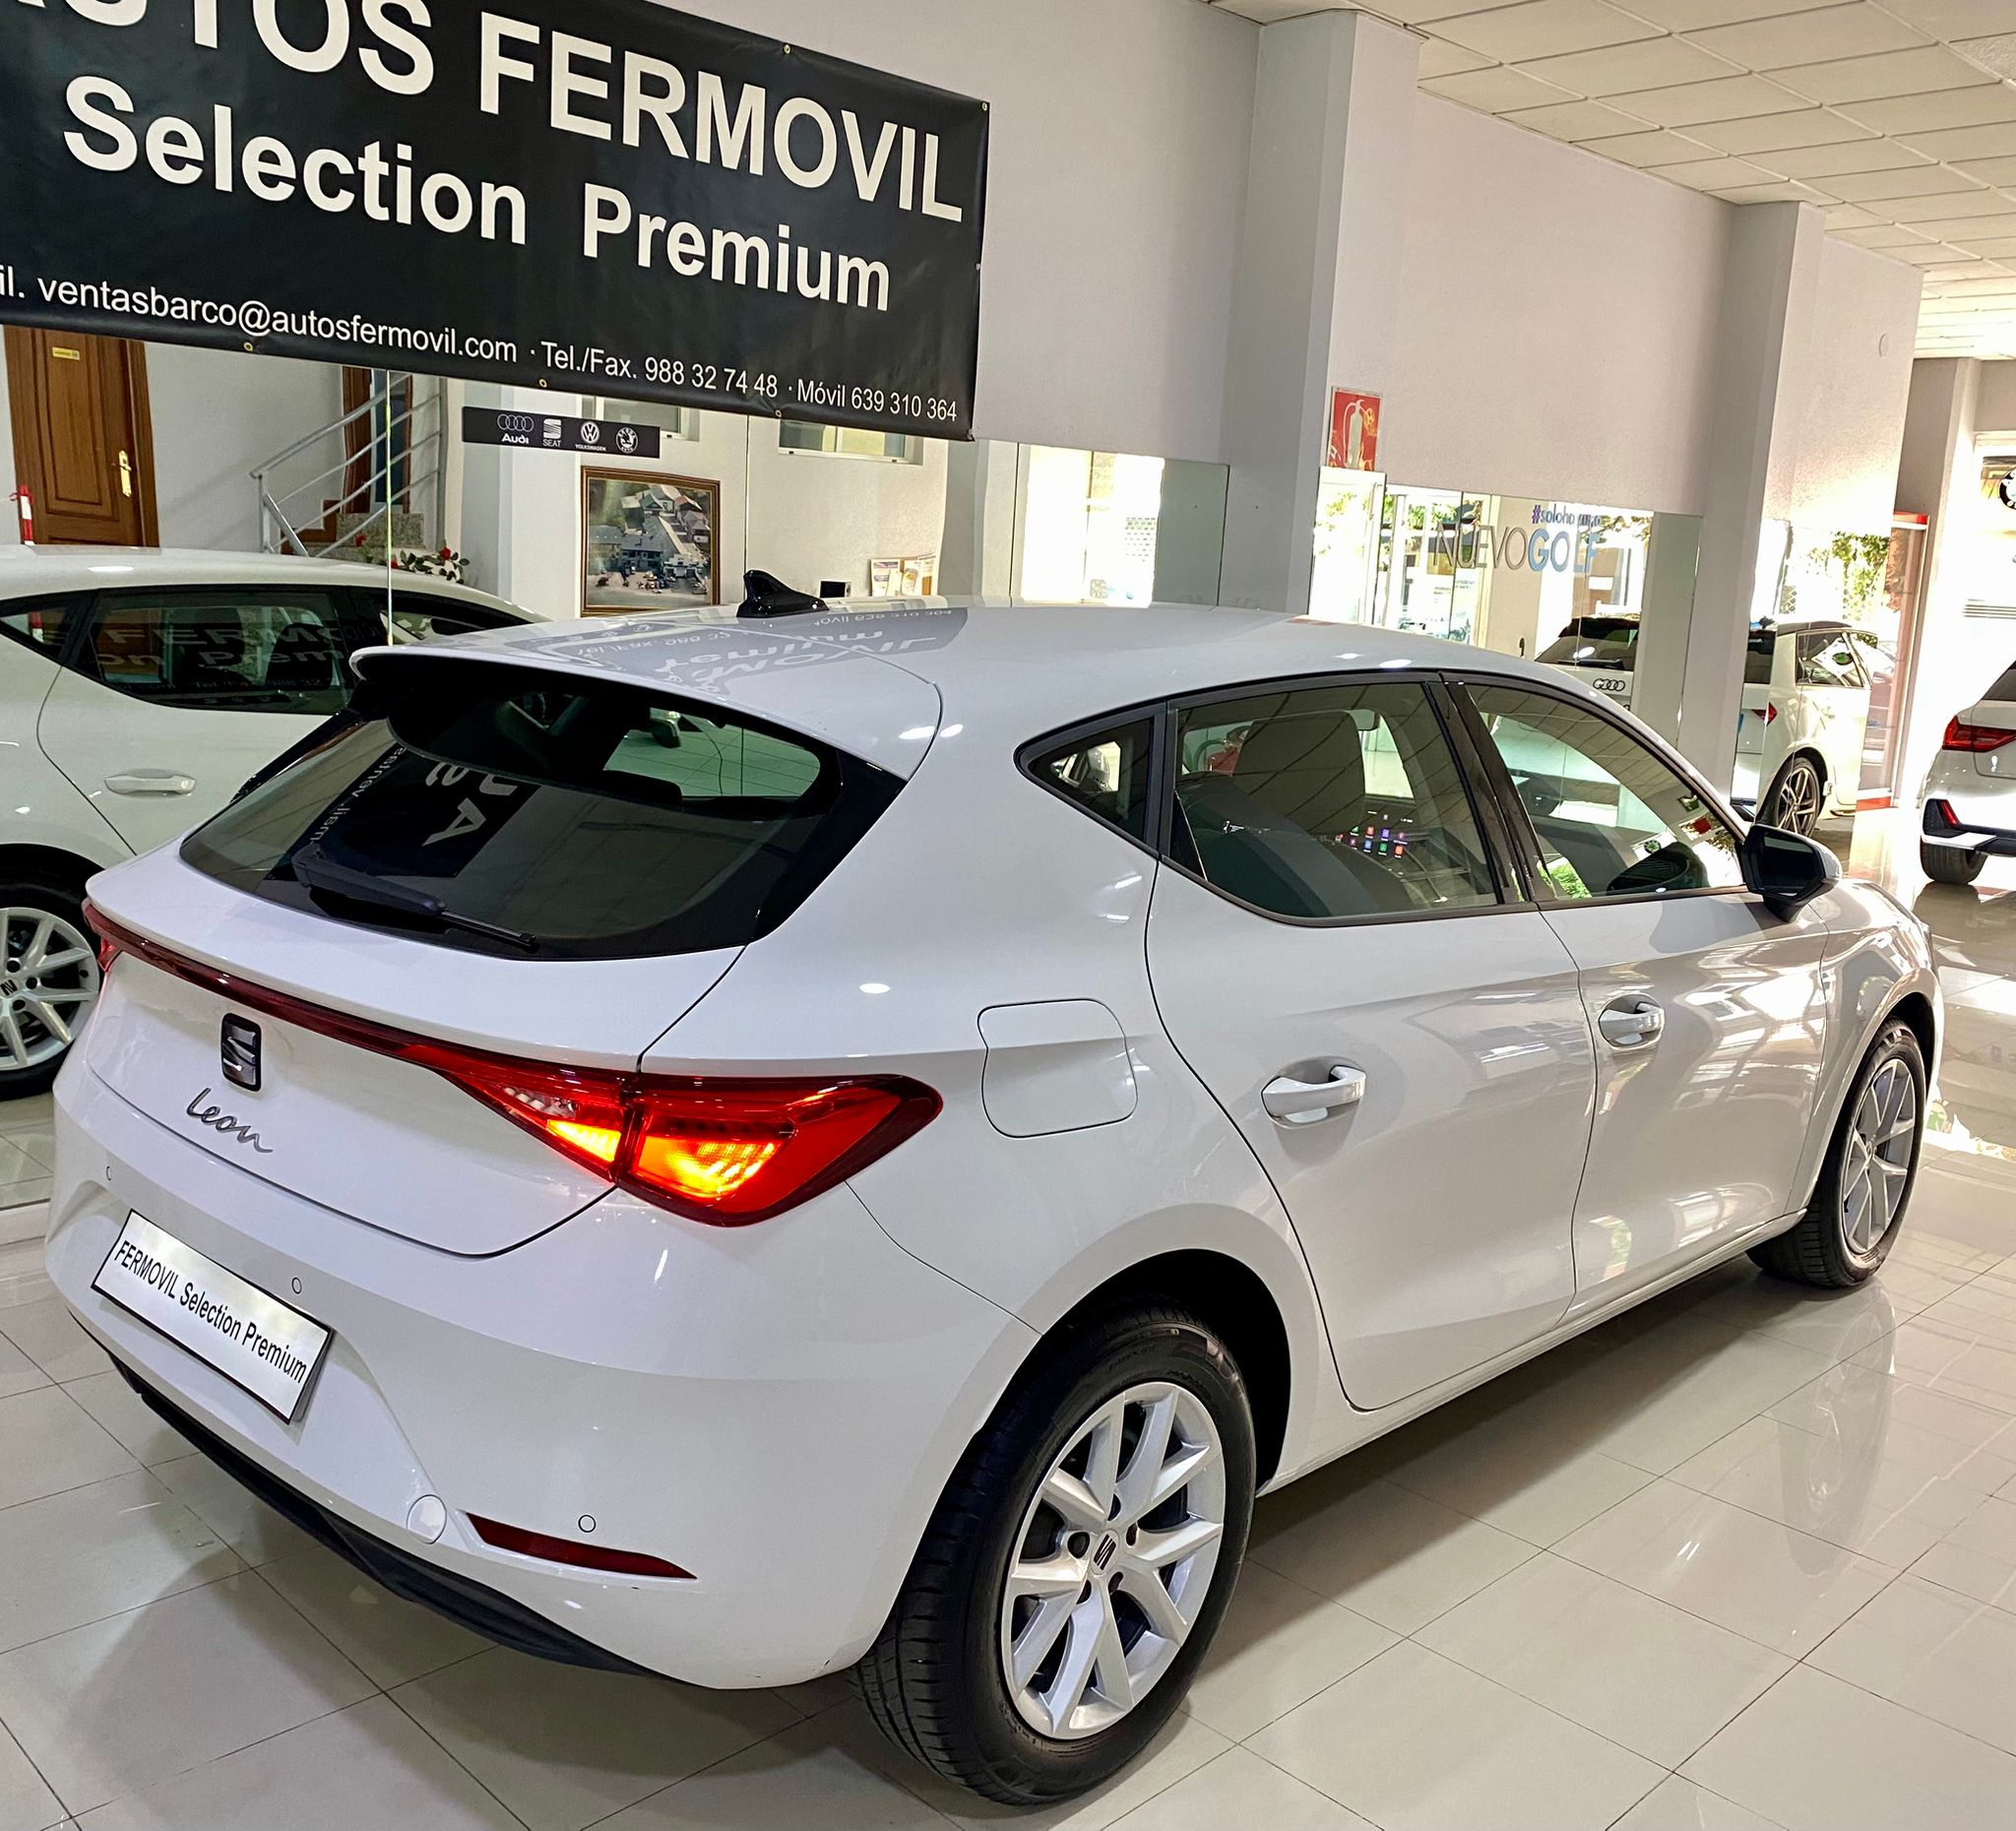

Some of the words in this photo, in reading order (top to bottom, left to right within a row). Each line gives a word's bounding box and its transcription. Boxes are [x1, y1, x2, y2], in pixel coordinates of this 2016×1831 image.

[480, 12, 963, 222] FERMOVIL
[63, 76, 527, 244] Selection
[584, 182, 890, 311] Premium
[36, 277, 517, 362] ventasbarco@autosfermovil.com
[540, 341, 638, 379] Tel./Fax.
[645, 356, 685, 385] 988
[691, 363, 717, 390] 32
[724, 367, 748, 395] 74
[753, 372, 778, 398] 48
[796, 378, 846, 407] Móvil
[850, 387, 885, 411] 639
[890, 392, 922, 417] 310
[926, 397, 958, 422] 364
[501, 433, 530, 444] Audi
[542, 438, 561, 448] SEAT
[185, 1086, 274, 1154] Leon
[114, 1240, 179, 1299] FERMOVIL
[180, 1282, 241, 1341] Selection
[241, 1321, 307, 1384] Premium
